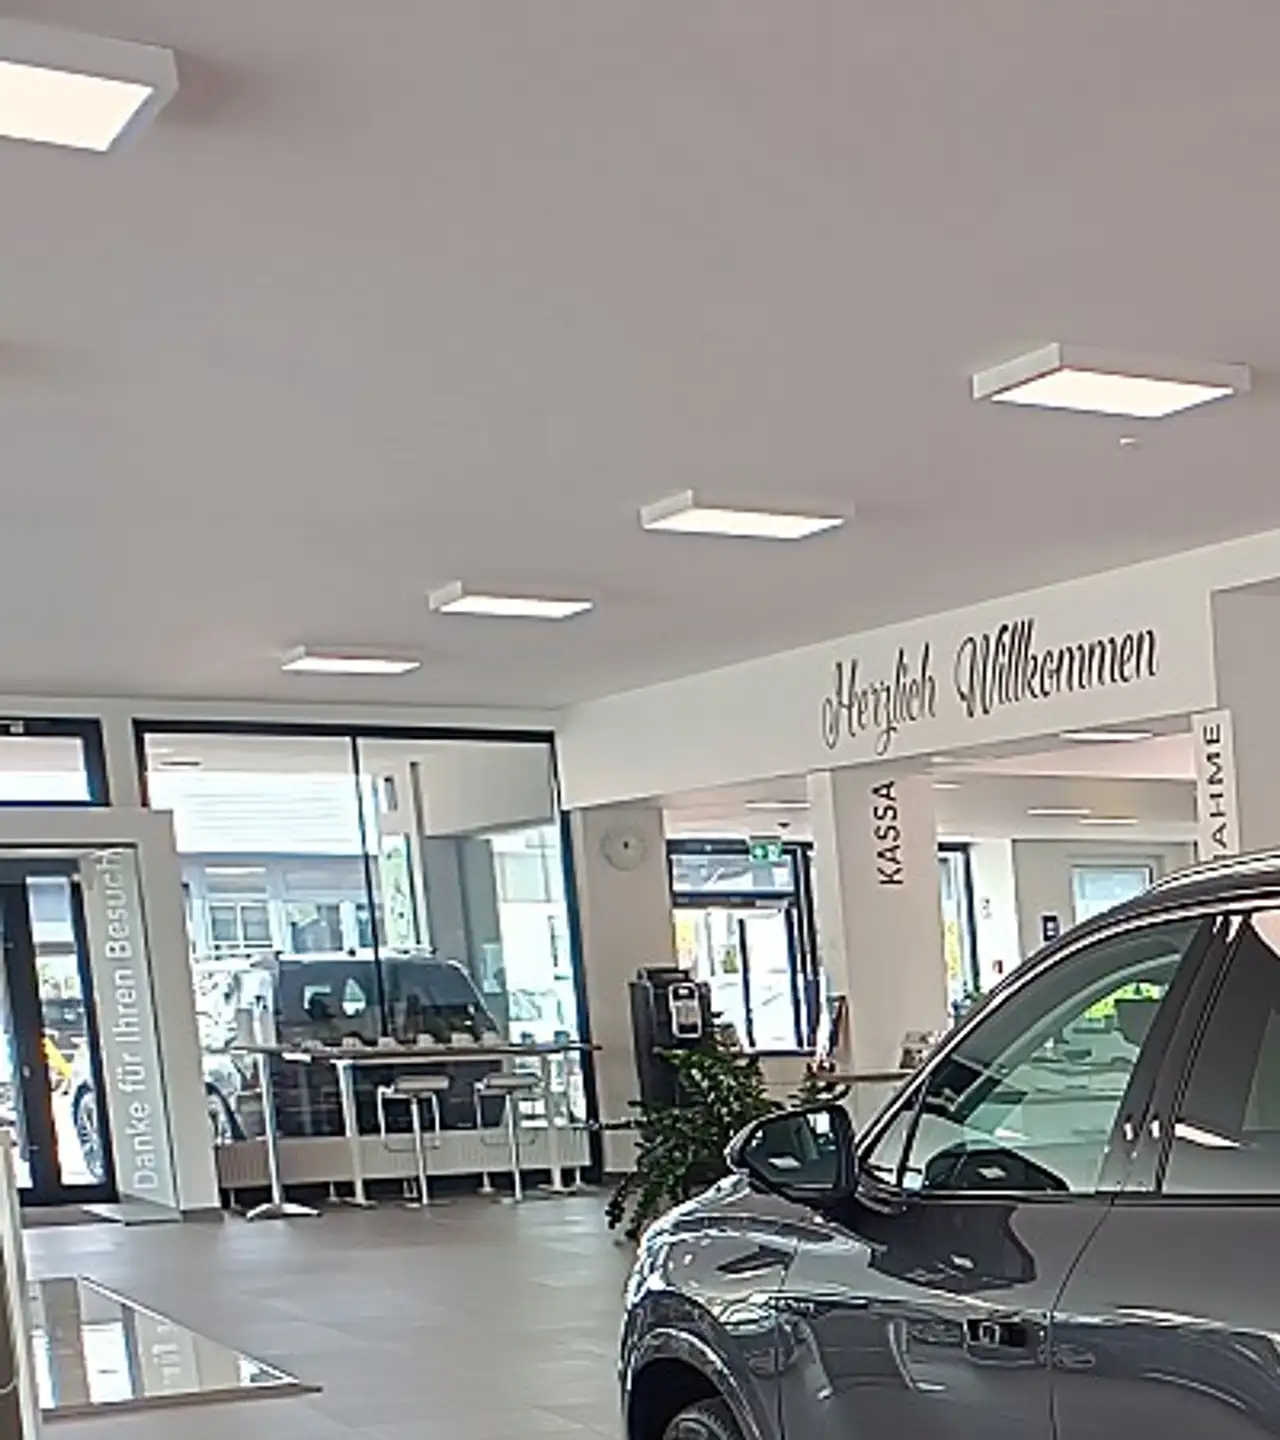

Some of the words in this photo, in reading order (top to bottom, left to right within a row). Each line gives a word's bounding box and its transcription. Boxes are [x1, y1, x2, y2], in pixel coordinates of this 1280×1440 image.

[822, 641, 937, 756] Herzlich
[954, 618, 1159, 718] Willkommen
[872, 780, 904, 885] KASSA
[1203, 724, 1227, 859] AHME
[97, 848, 133, 959] Besuch
[111, 968, 142, 1042] Ihren
[115, 1052, 147, 1092] für
[125, 1101, 159, 1190] Danke
